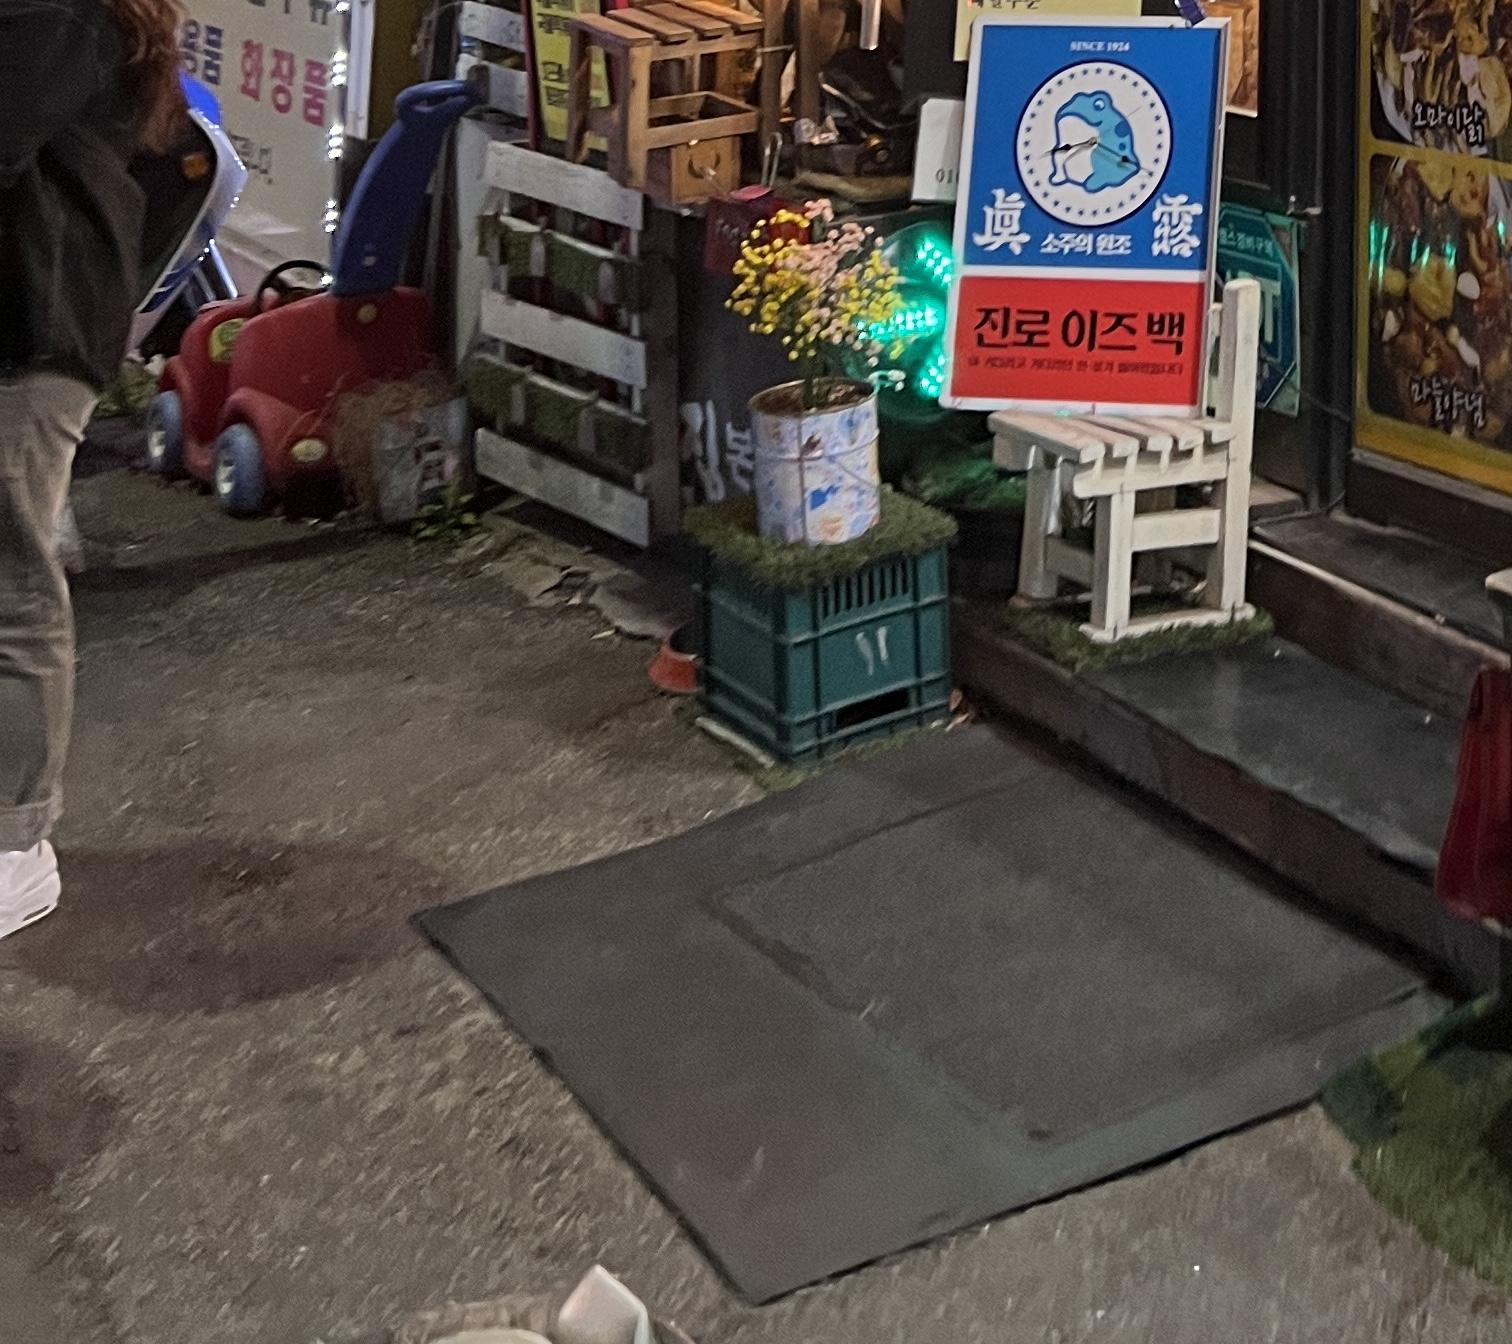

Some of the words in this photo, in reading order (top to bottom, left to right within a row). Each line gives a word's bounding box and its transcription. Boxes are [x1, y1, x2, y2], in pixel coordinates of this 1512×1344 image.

[1069, 40, 1105, 52] SINCE
[1414, 102, 1485, 143] 오마이닭
[1040, 233, 1093, 256] 소주의
[1096, 234, 1132, 256] 원조
[974, 306, 1050, 349] 진로
[1061, 309, 1138, 353] 이즈
[1147, 311, 1185, 356] 백
